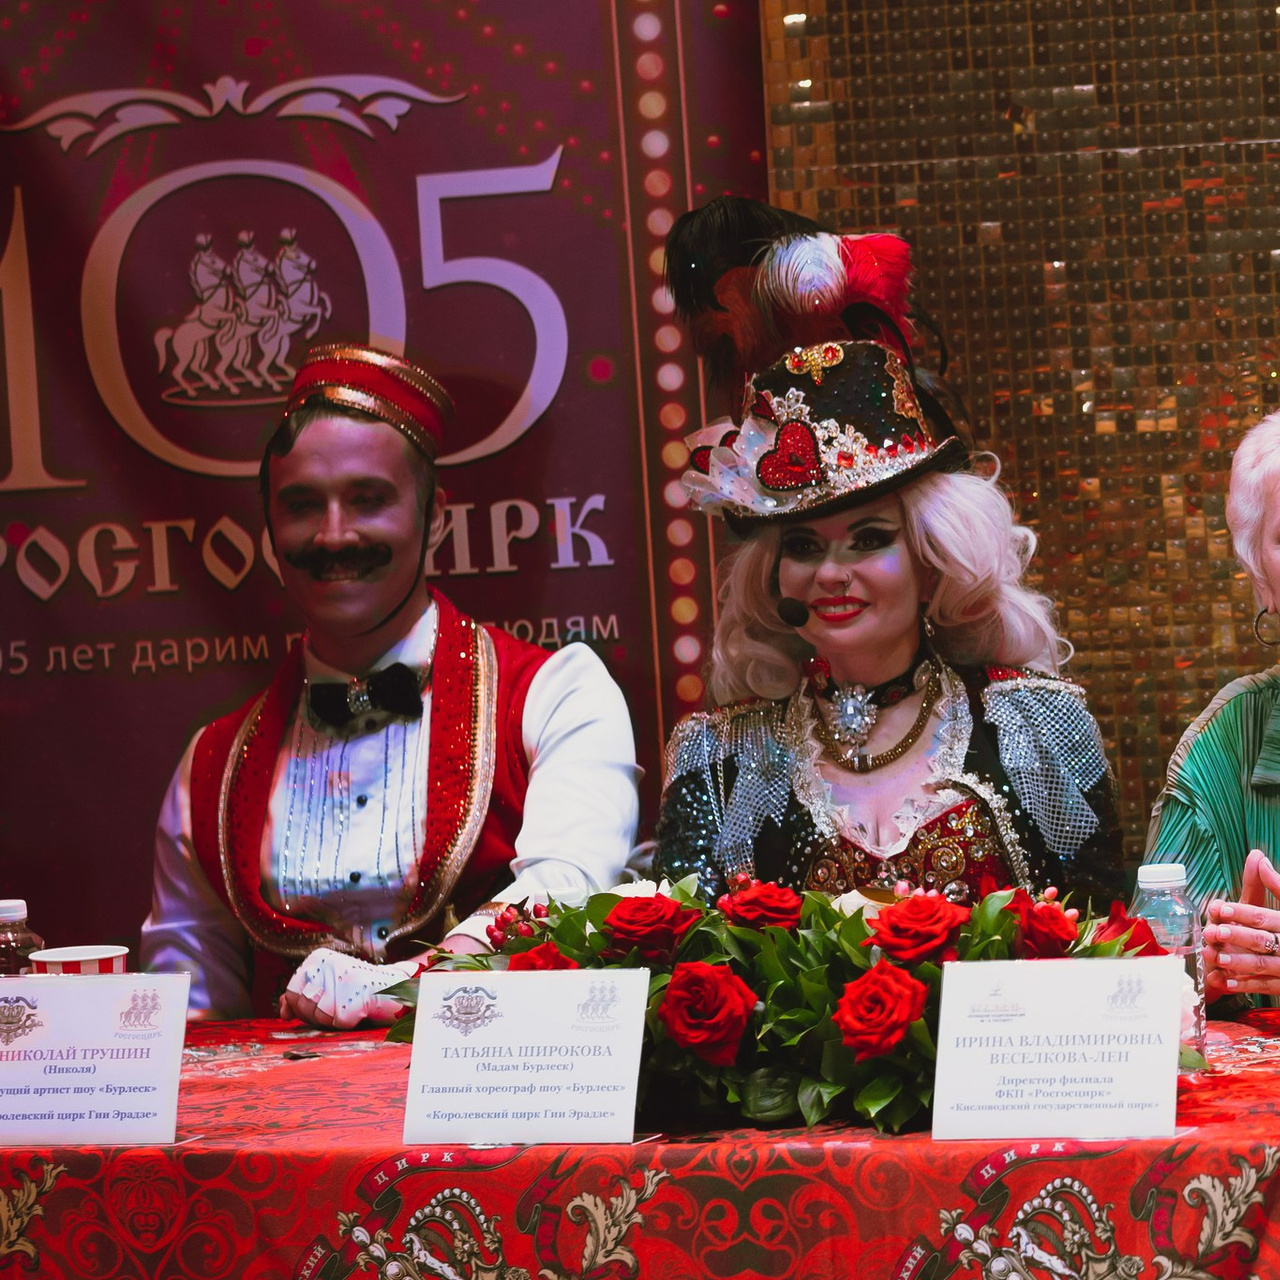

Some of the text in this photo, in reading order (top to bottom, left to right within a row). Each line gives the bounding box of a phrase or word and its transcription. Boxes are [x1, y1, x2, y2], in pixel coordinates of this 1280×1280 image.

[0, 494, 614, 601] ОСГОИРК
[46, 642, 116, 673] лет
[131, 634, 270, 674] дарим
[482, 614, 620, 649] юдям
[955, 1033, 1163, 1048] ИРИНА ВЛАДИМИРОВНА
[80, 1047, 151, 1060] ТРУШИН
[441, 1044, 613, 1059] ТАТЬЯНА ШИРОКОВА
[989, 1050, 1130, 1065] ВЕСЕЛКОВА-ЛЕН
[43, 1064, 96, 1075] (Николя)
[476, 1061, 574, 1073] (Мадам Бурлеск)
[997, 1074, 1114, 1086] Директор филиала
[33, 1086, 70, 1096] артист
[73, 1086, 96, 1096] шоу
[99, 1083, 157, 1096] «Бурлеск»
[421, 1083, 626, 1095] Главный хореограф шоу «Бурлеск»
[995, 1088, 1112, 1100] ФКП «Росгосцирк»
[57, 1111, 85, 1121] цирк
[88, 1110, 109, 1119] Гии
[112, 1109, 157, 1121] Эрадзе»
[426, 1109, 615, 1121] «Королевский цирк Гии Эрадзе»
[979, 1141, 1066, 1180] ЦИРК
[374, 1151, 454, 1186] ЦИРК
